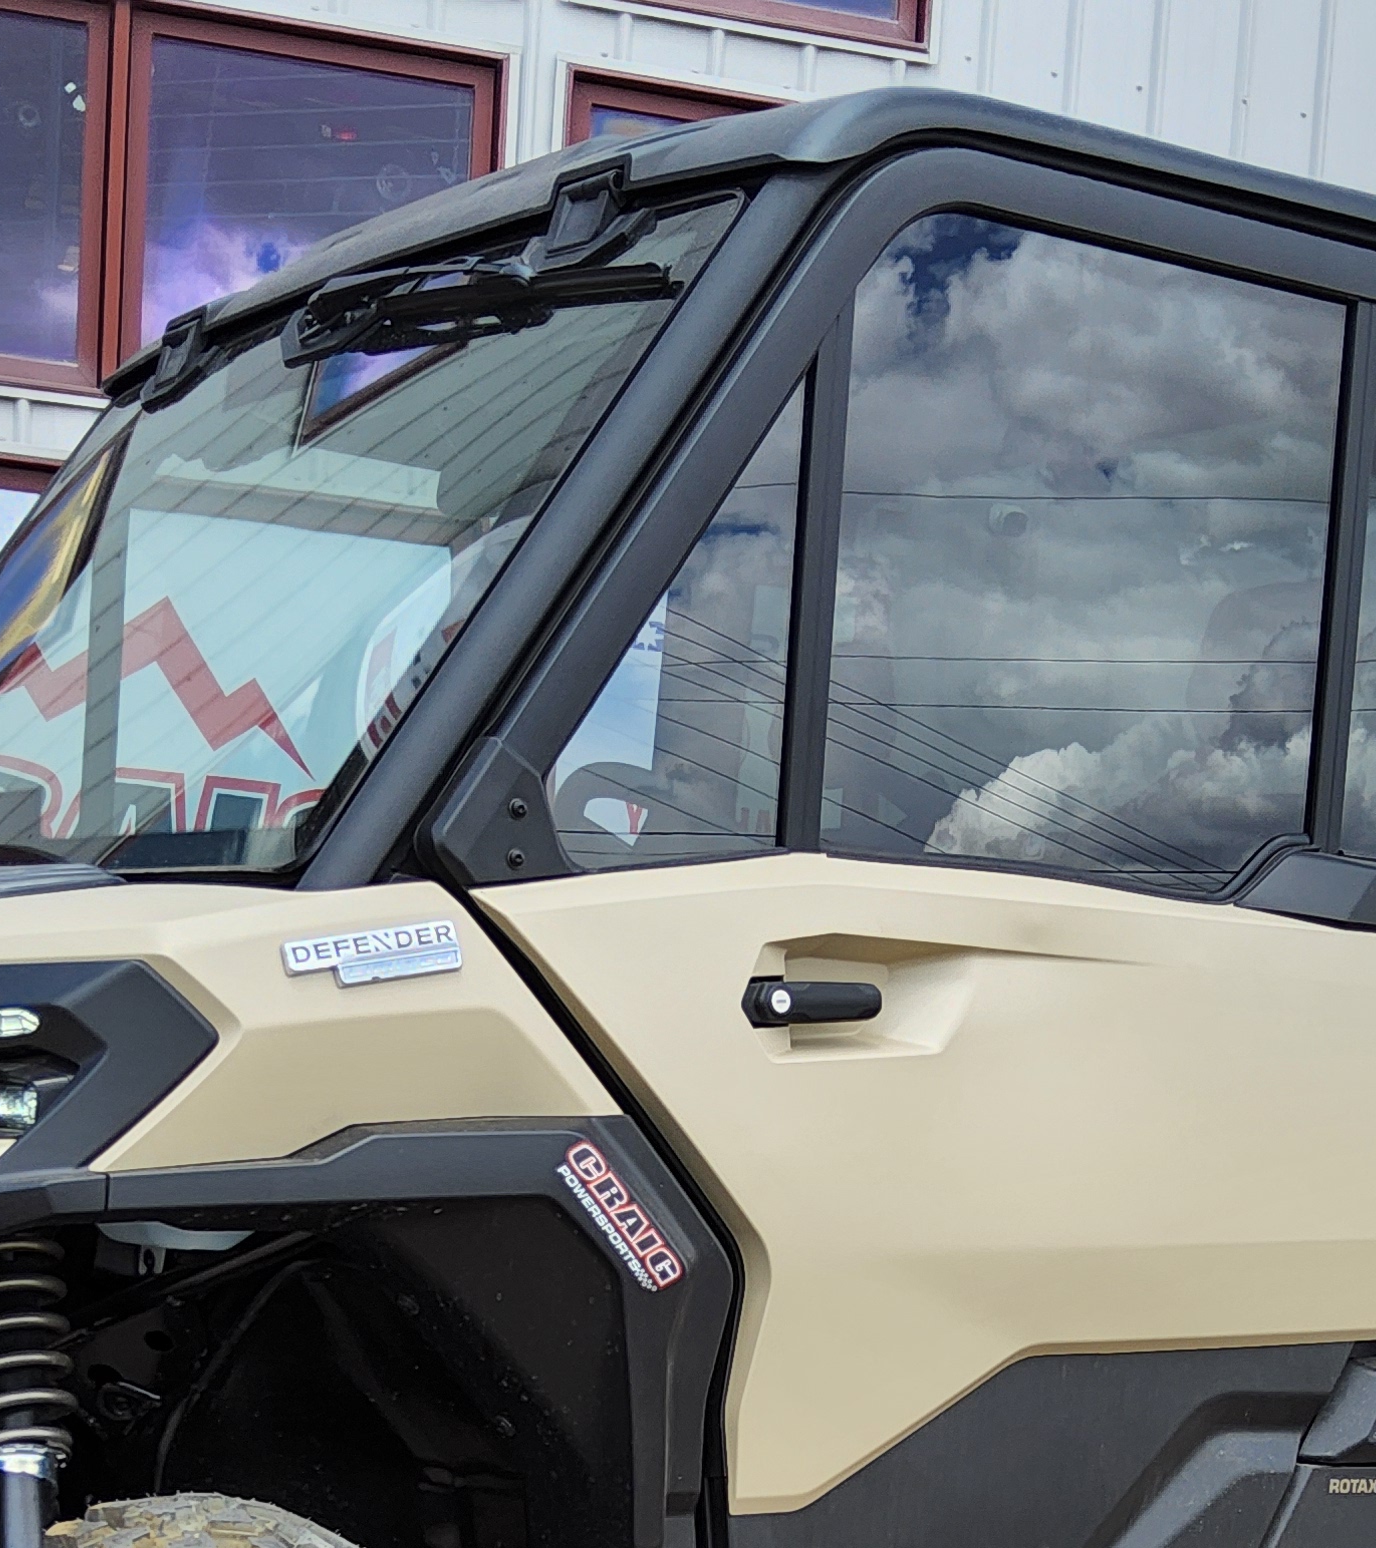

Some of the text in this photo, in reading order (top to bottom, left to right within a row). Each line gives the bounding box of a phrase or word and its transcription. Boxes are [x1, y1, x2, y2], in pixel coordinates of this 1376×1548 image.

[291, 925, 454, 963] DEFENDER
[556, 1164, 642, 1273] POWERSPORTS
[566, 1141, 683, 1289] CRAIG
